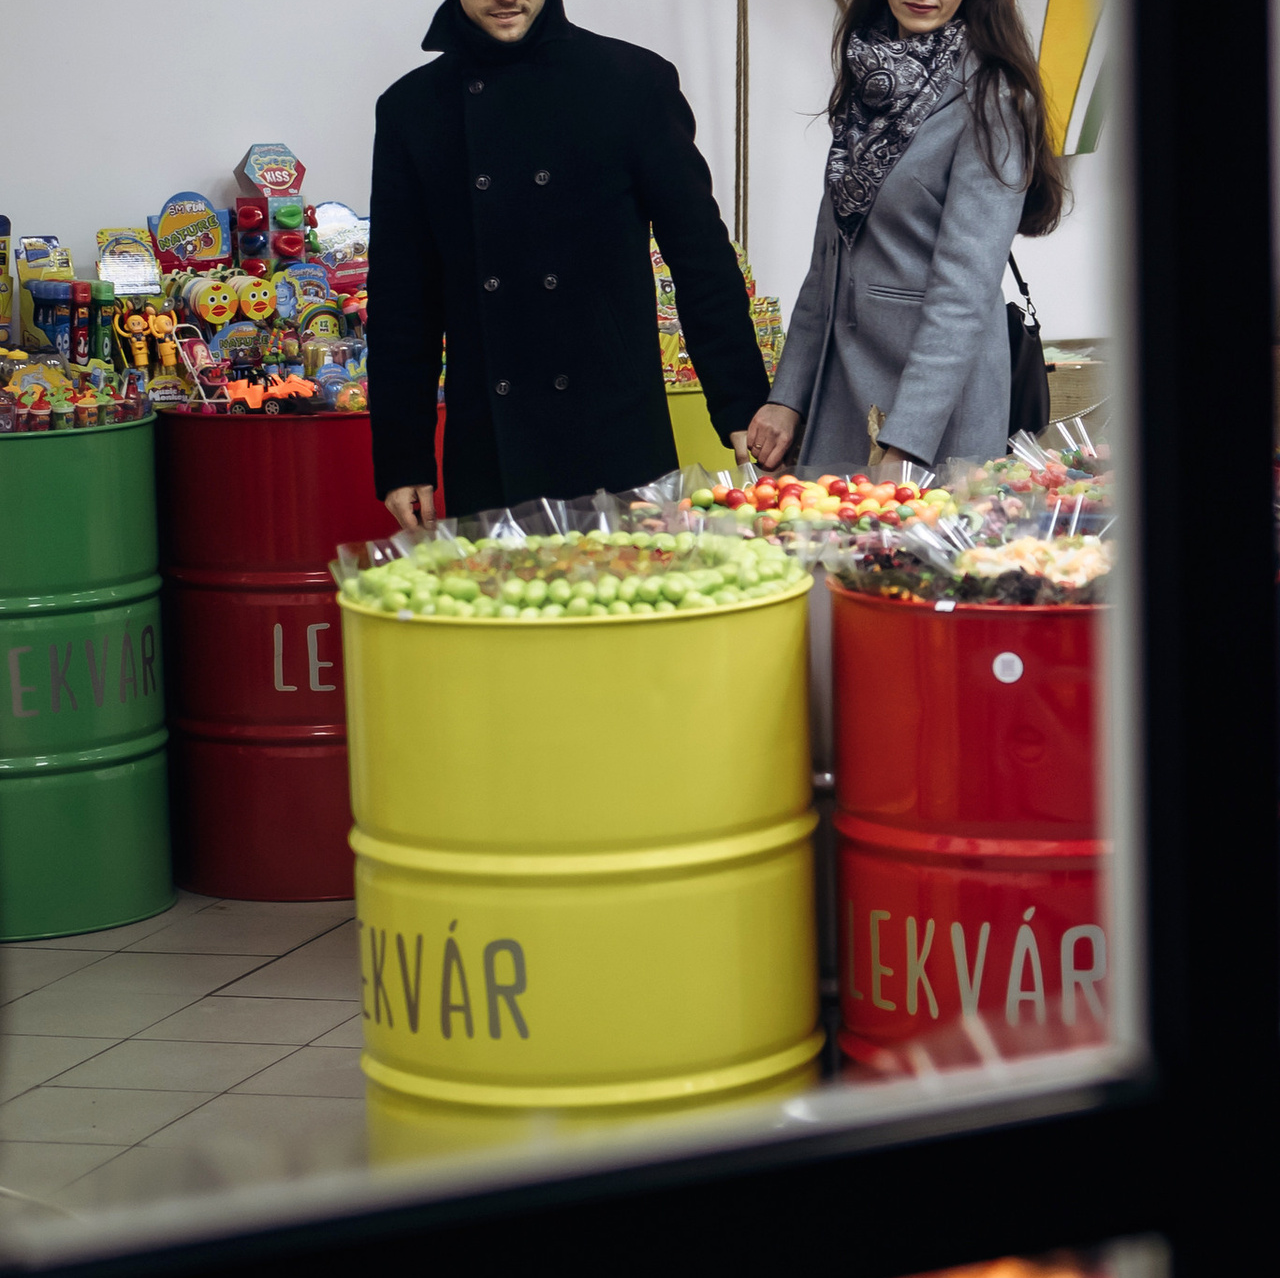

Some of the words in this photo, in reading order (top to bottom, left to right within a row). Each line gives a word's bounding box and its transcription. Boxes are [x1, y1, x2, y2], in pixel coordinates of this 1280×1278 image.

[263, 170, 291, 183] KISS
[158, 213, 220, 252] NATURE
[358, 919, 530, 1040] KVÁR
